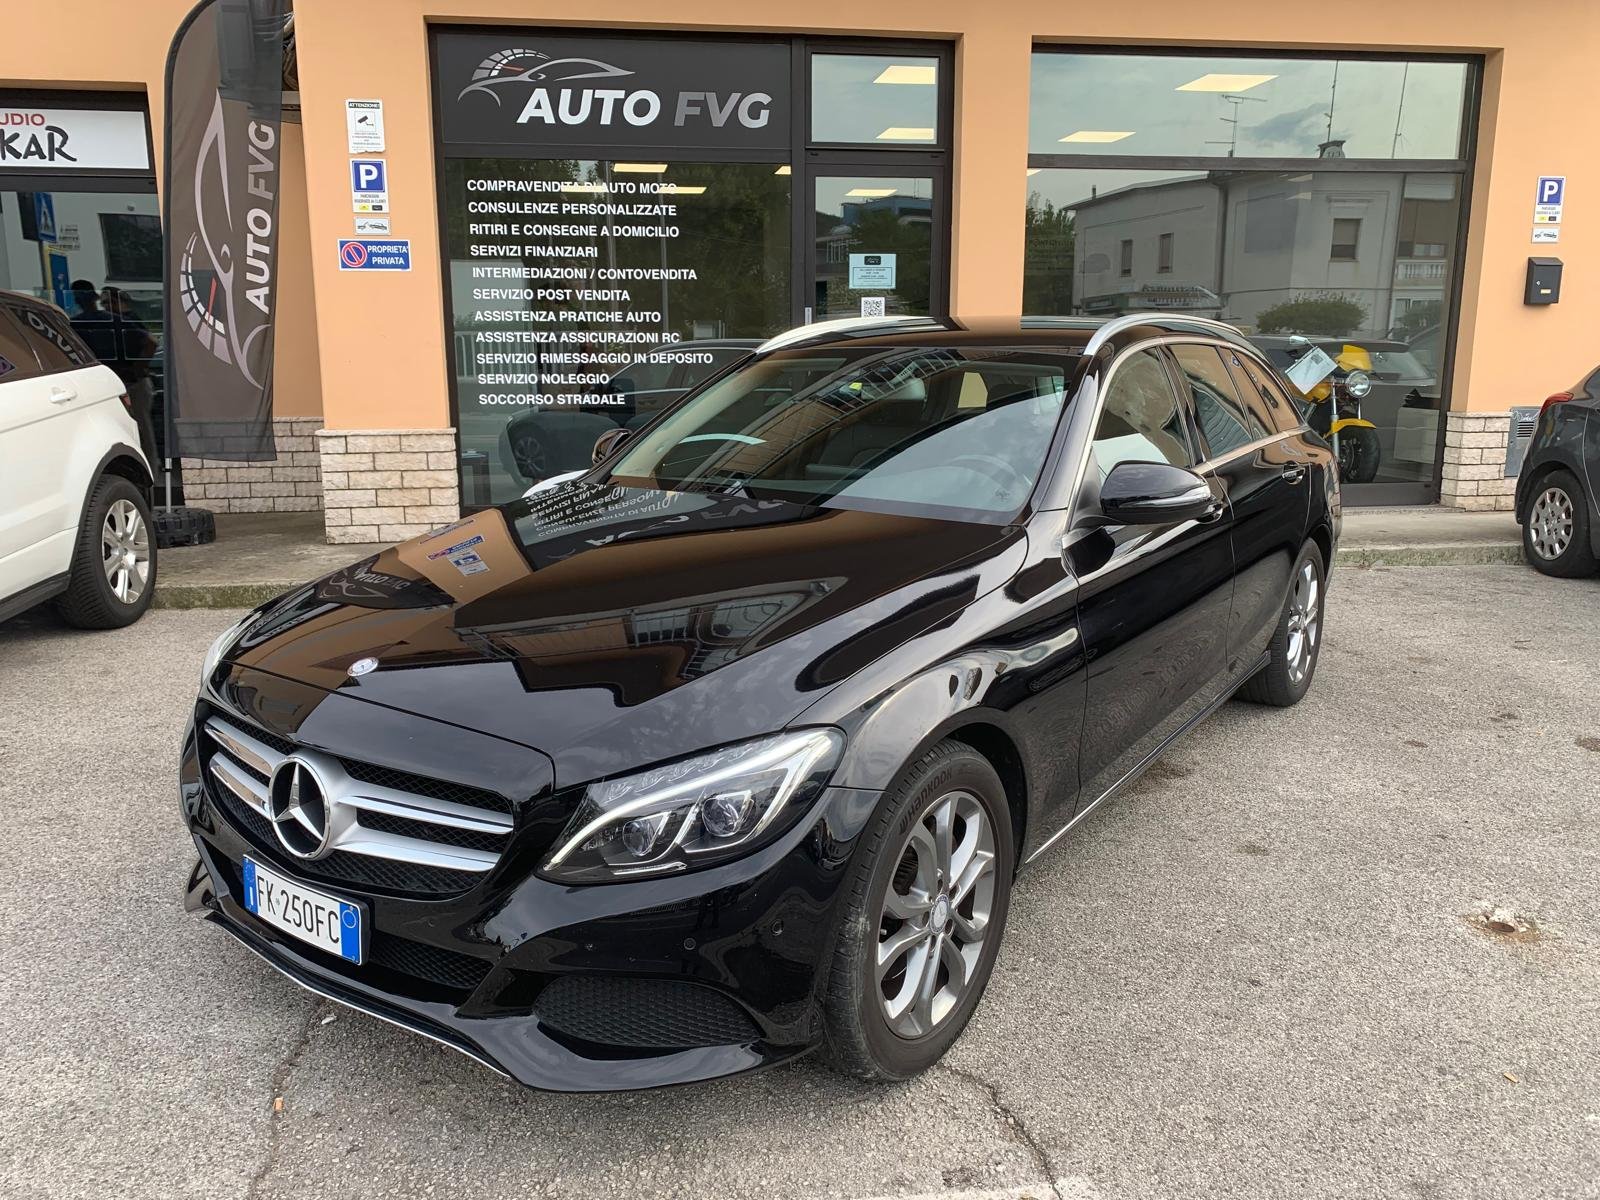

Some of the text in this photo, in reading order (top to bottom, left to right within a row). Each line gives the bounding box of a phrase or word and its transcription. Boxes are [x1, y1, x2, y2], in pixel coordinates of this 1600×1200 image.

[516, 88, 773, 128] AUTO FVG
[359, 164, 378, 189] P
[467, 180, 580, 193] COMPRAVENDITA
[600, 182, 636, 194] AUTO
[639, 183, 677, 194] MOTO
[1542, 181, 1559, 202] P
[468, 202, 677, 216] CONSULENZE PERSONALIZZATE
[245, 120, 276, 314] AUTO FVG
[469, 224, 679, 237] RITIRI E CONSEGNE A DOMICILIO
[470, 245, 598, 258] SERVIZI FINANZIARI
[372, 256, 405, 265] PRIVATA
[472, 267, 587, 279] INTERMEDIAZIONI
[597, 268, 698, 280] CONTOVENDITA
[473, 289, 630, 301] SERVIZIO POST VENDITA
[474, 311, 661, 323] ASSISTENZA PRATICHE AUTO
[475, 331, 681, 344] ASSISTENZA ASSICURAZIONI RC
[476, 353, 713, 364] SERVIZIO RIMESSAGGIO IN DEPOSITO
[478, 374, 610, 385] SERVIZIO NOLEGGIO
[479, 394, 625, 405] SOCCORSO STRADALE
[257, 875, 340, 944] FK 250FC
